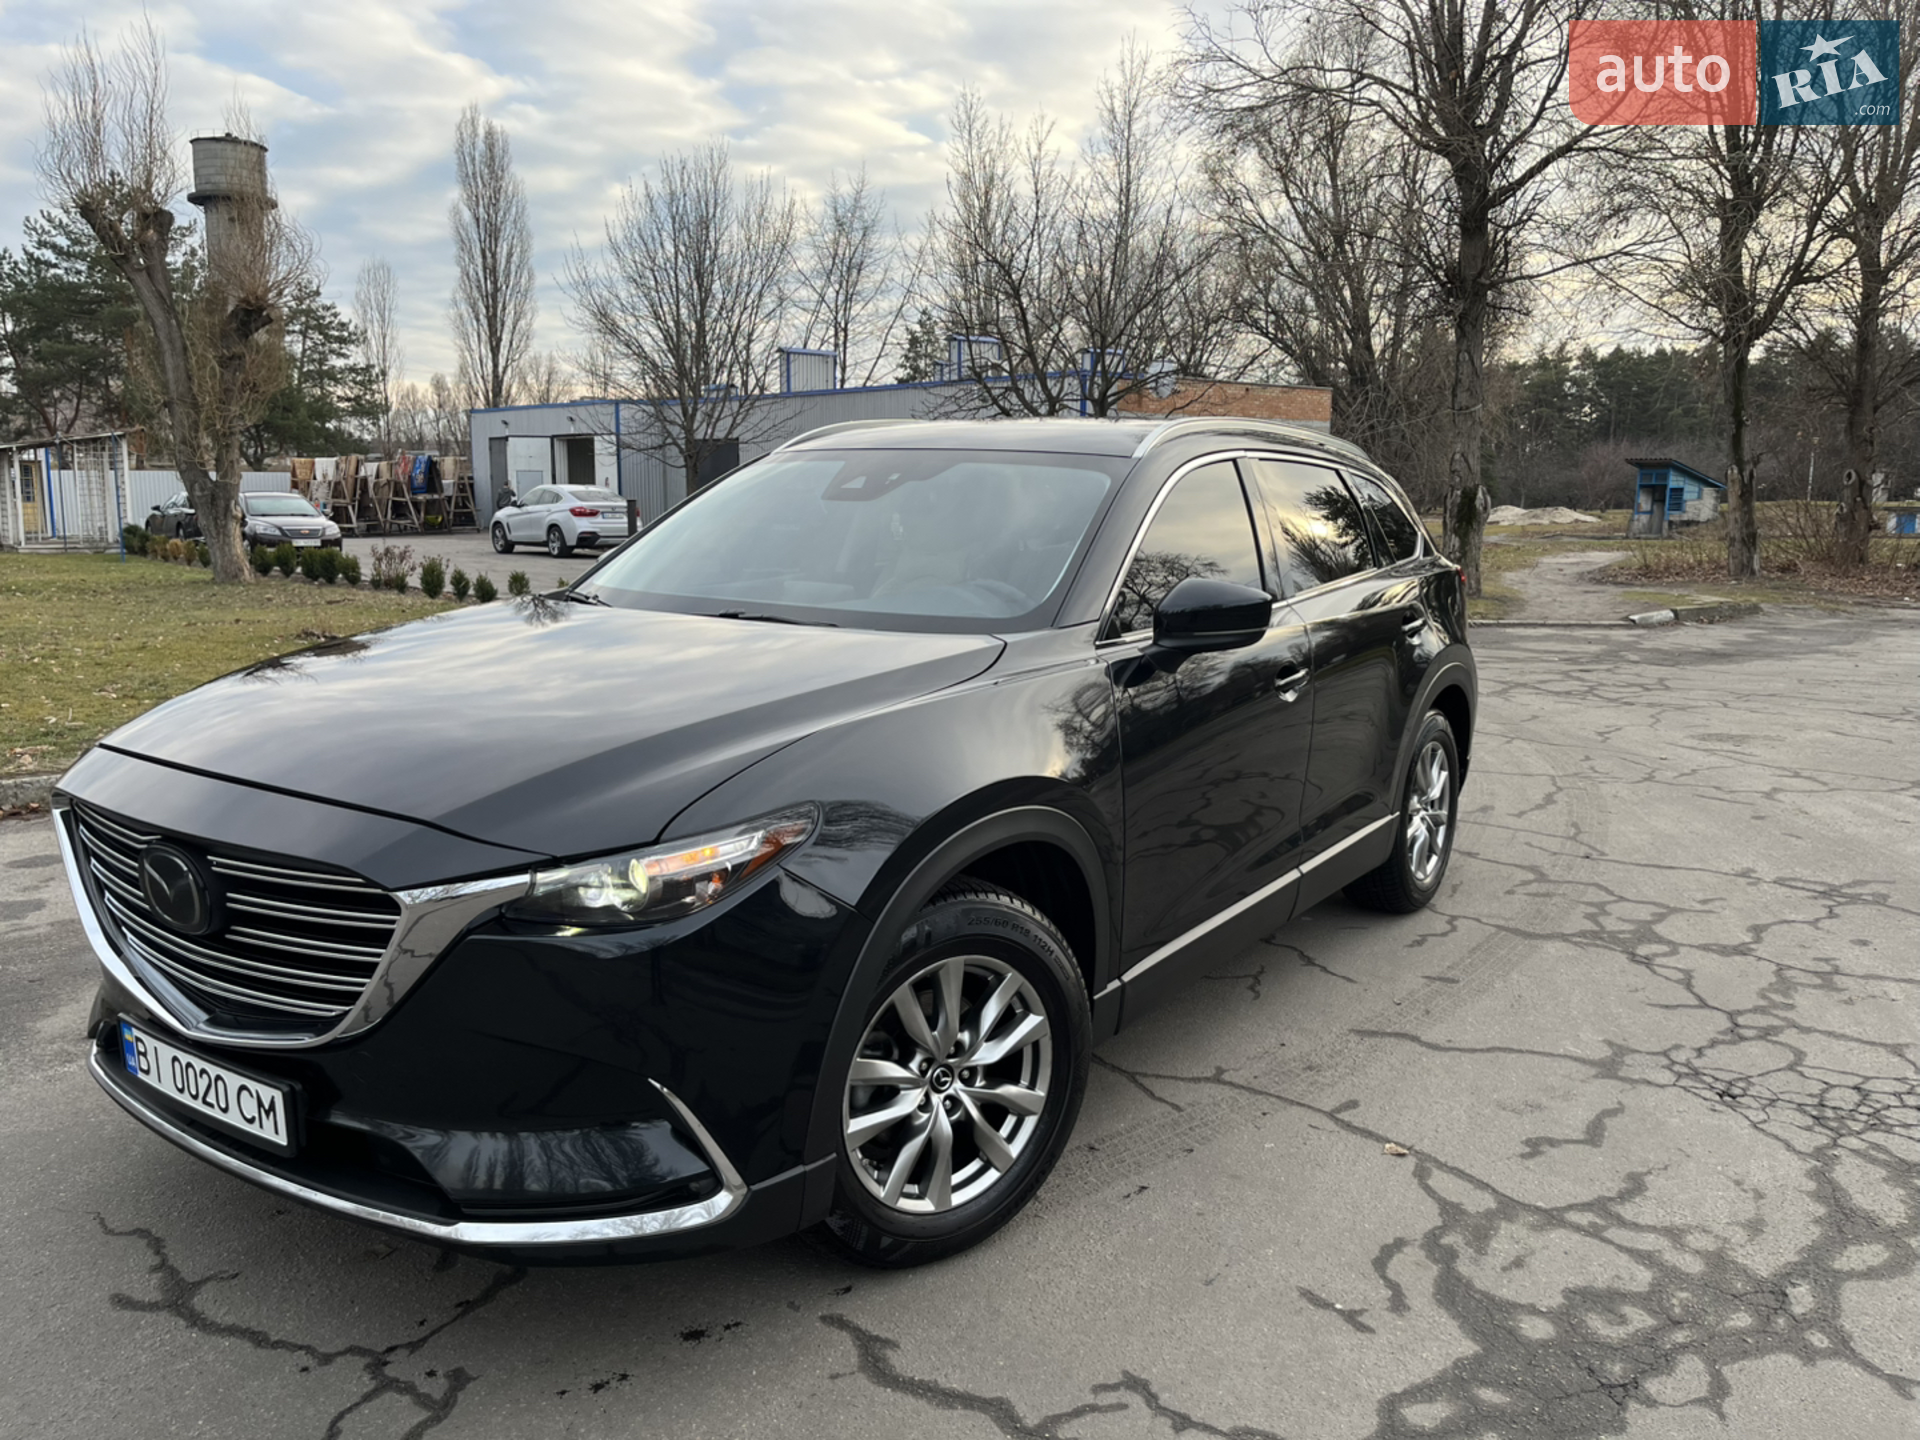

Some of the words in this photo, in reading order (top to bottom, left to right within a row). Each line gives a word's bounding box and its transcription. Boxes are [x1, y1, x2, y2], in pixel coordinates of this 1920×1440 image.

[967, 916, 1009, 929] 255/60
[1010, 922, 1031, 938] R18
[1032, 934, 1055, 957] 112H
[134, 1035, 161, 1083] BI
[171, 1055, 230, 1114] 0020
[237, 1084, 279, 1135] CM
